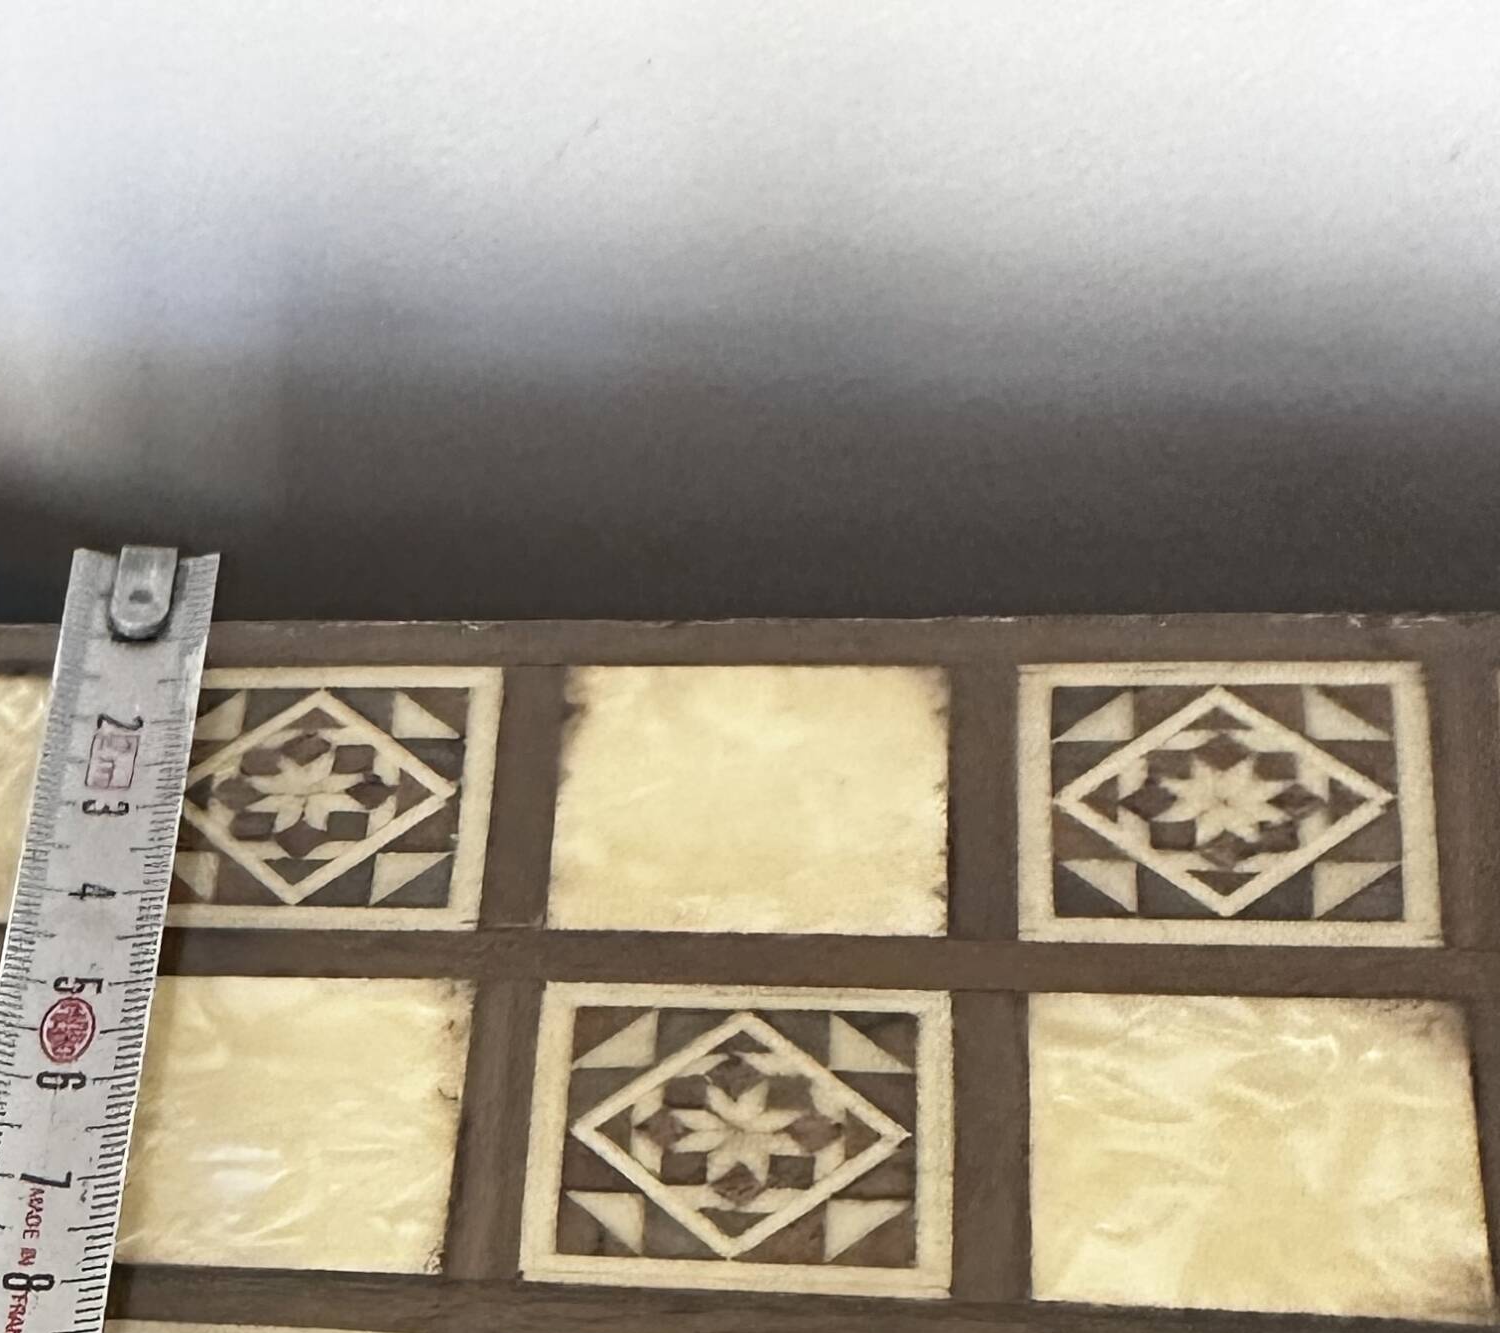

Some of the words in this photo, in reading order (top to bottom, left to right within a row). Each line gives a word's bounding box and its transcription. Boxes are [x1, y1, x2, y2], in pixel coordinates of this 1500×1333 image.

[97, 713, 144, 731] 2
[82, 800, 130, 816] 3
[68, 883, 116, 898] 4
[53, 976, 104, 994] 5
[36, 1071, 87, 1091] 6
[19, 1171, 72, 1189] 7
[22, 1187, 45, 1240] MADE
[18, 1247, 38, 1267] IN
[2, 1272, 55, 1292] 8
